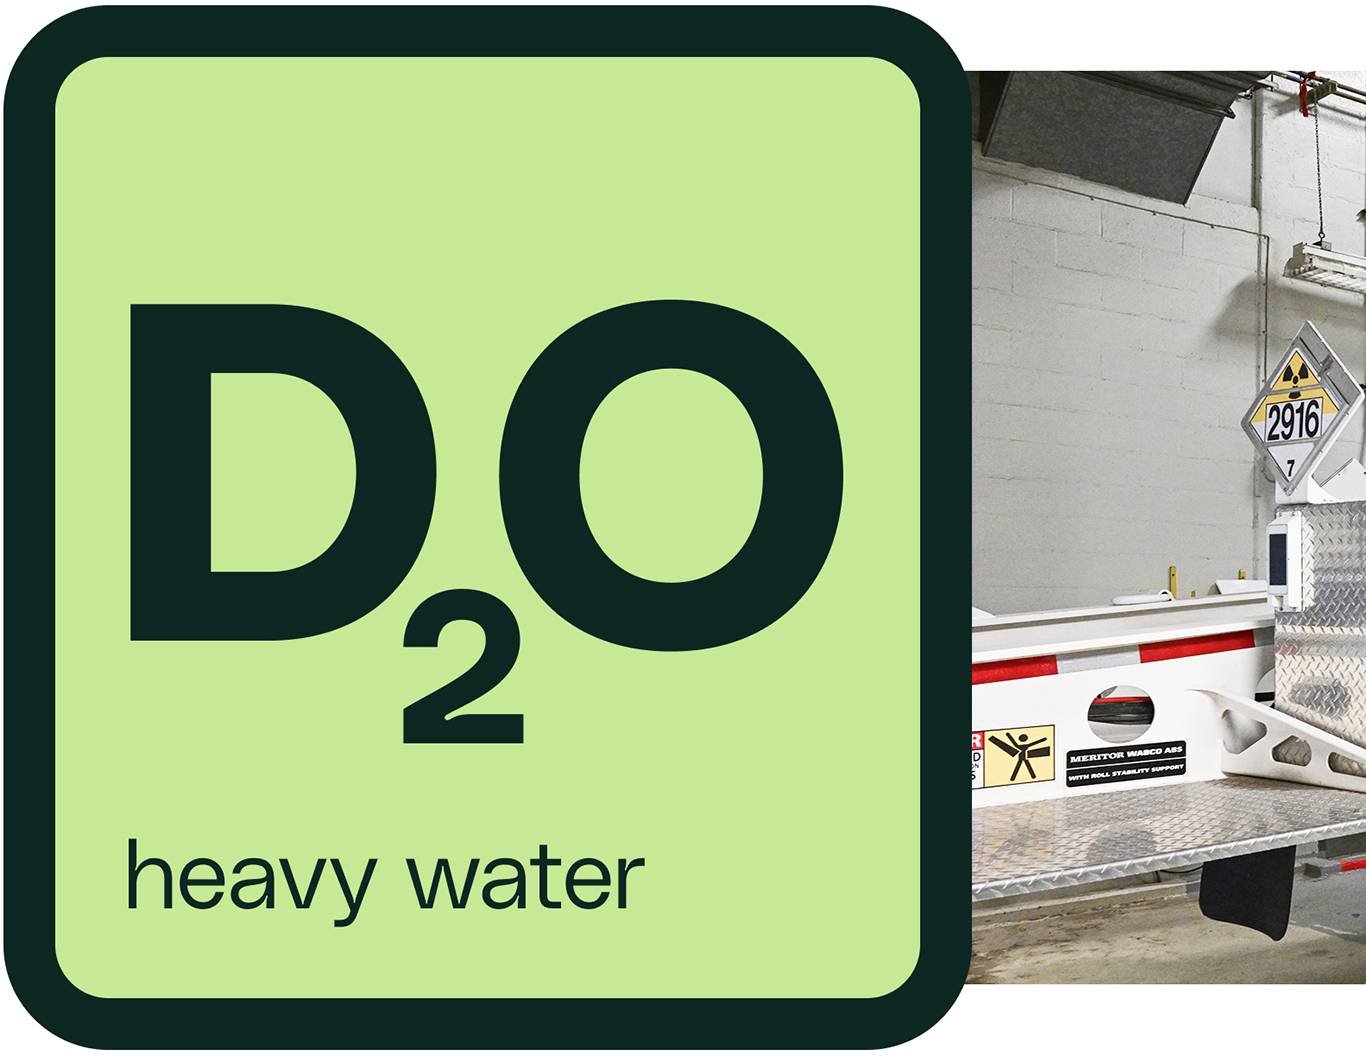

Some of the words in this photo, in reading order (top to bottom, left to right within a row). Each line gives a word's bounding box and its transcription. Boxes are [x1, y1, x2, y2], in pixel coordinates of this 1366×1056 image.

[1267, 399, 1320, 441] 2916
[1286, 459, 1295, 477] 7
[1069, 751, 1125, 763] MERITOR
[1126, 748, 1163, 758] WABCO
[1164, 746, 1183, 754] ABS
[1068, 774, 1090, 782] WITH
[1112, 767, 1150, 777] STABILITY
[1151, 764, 1184, 773] SUPPORT
